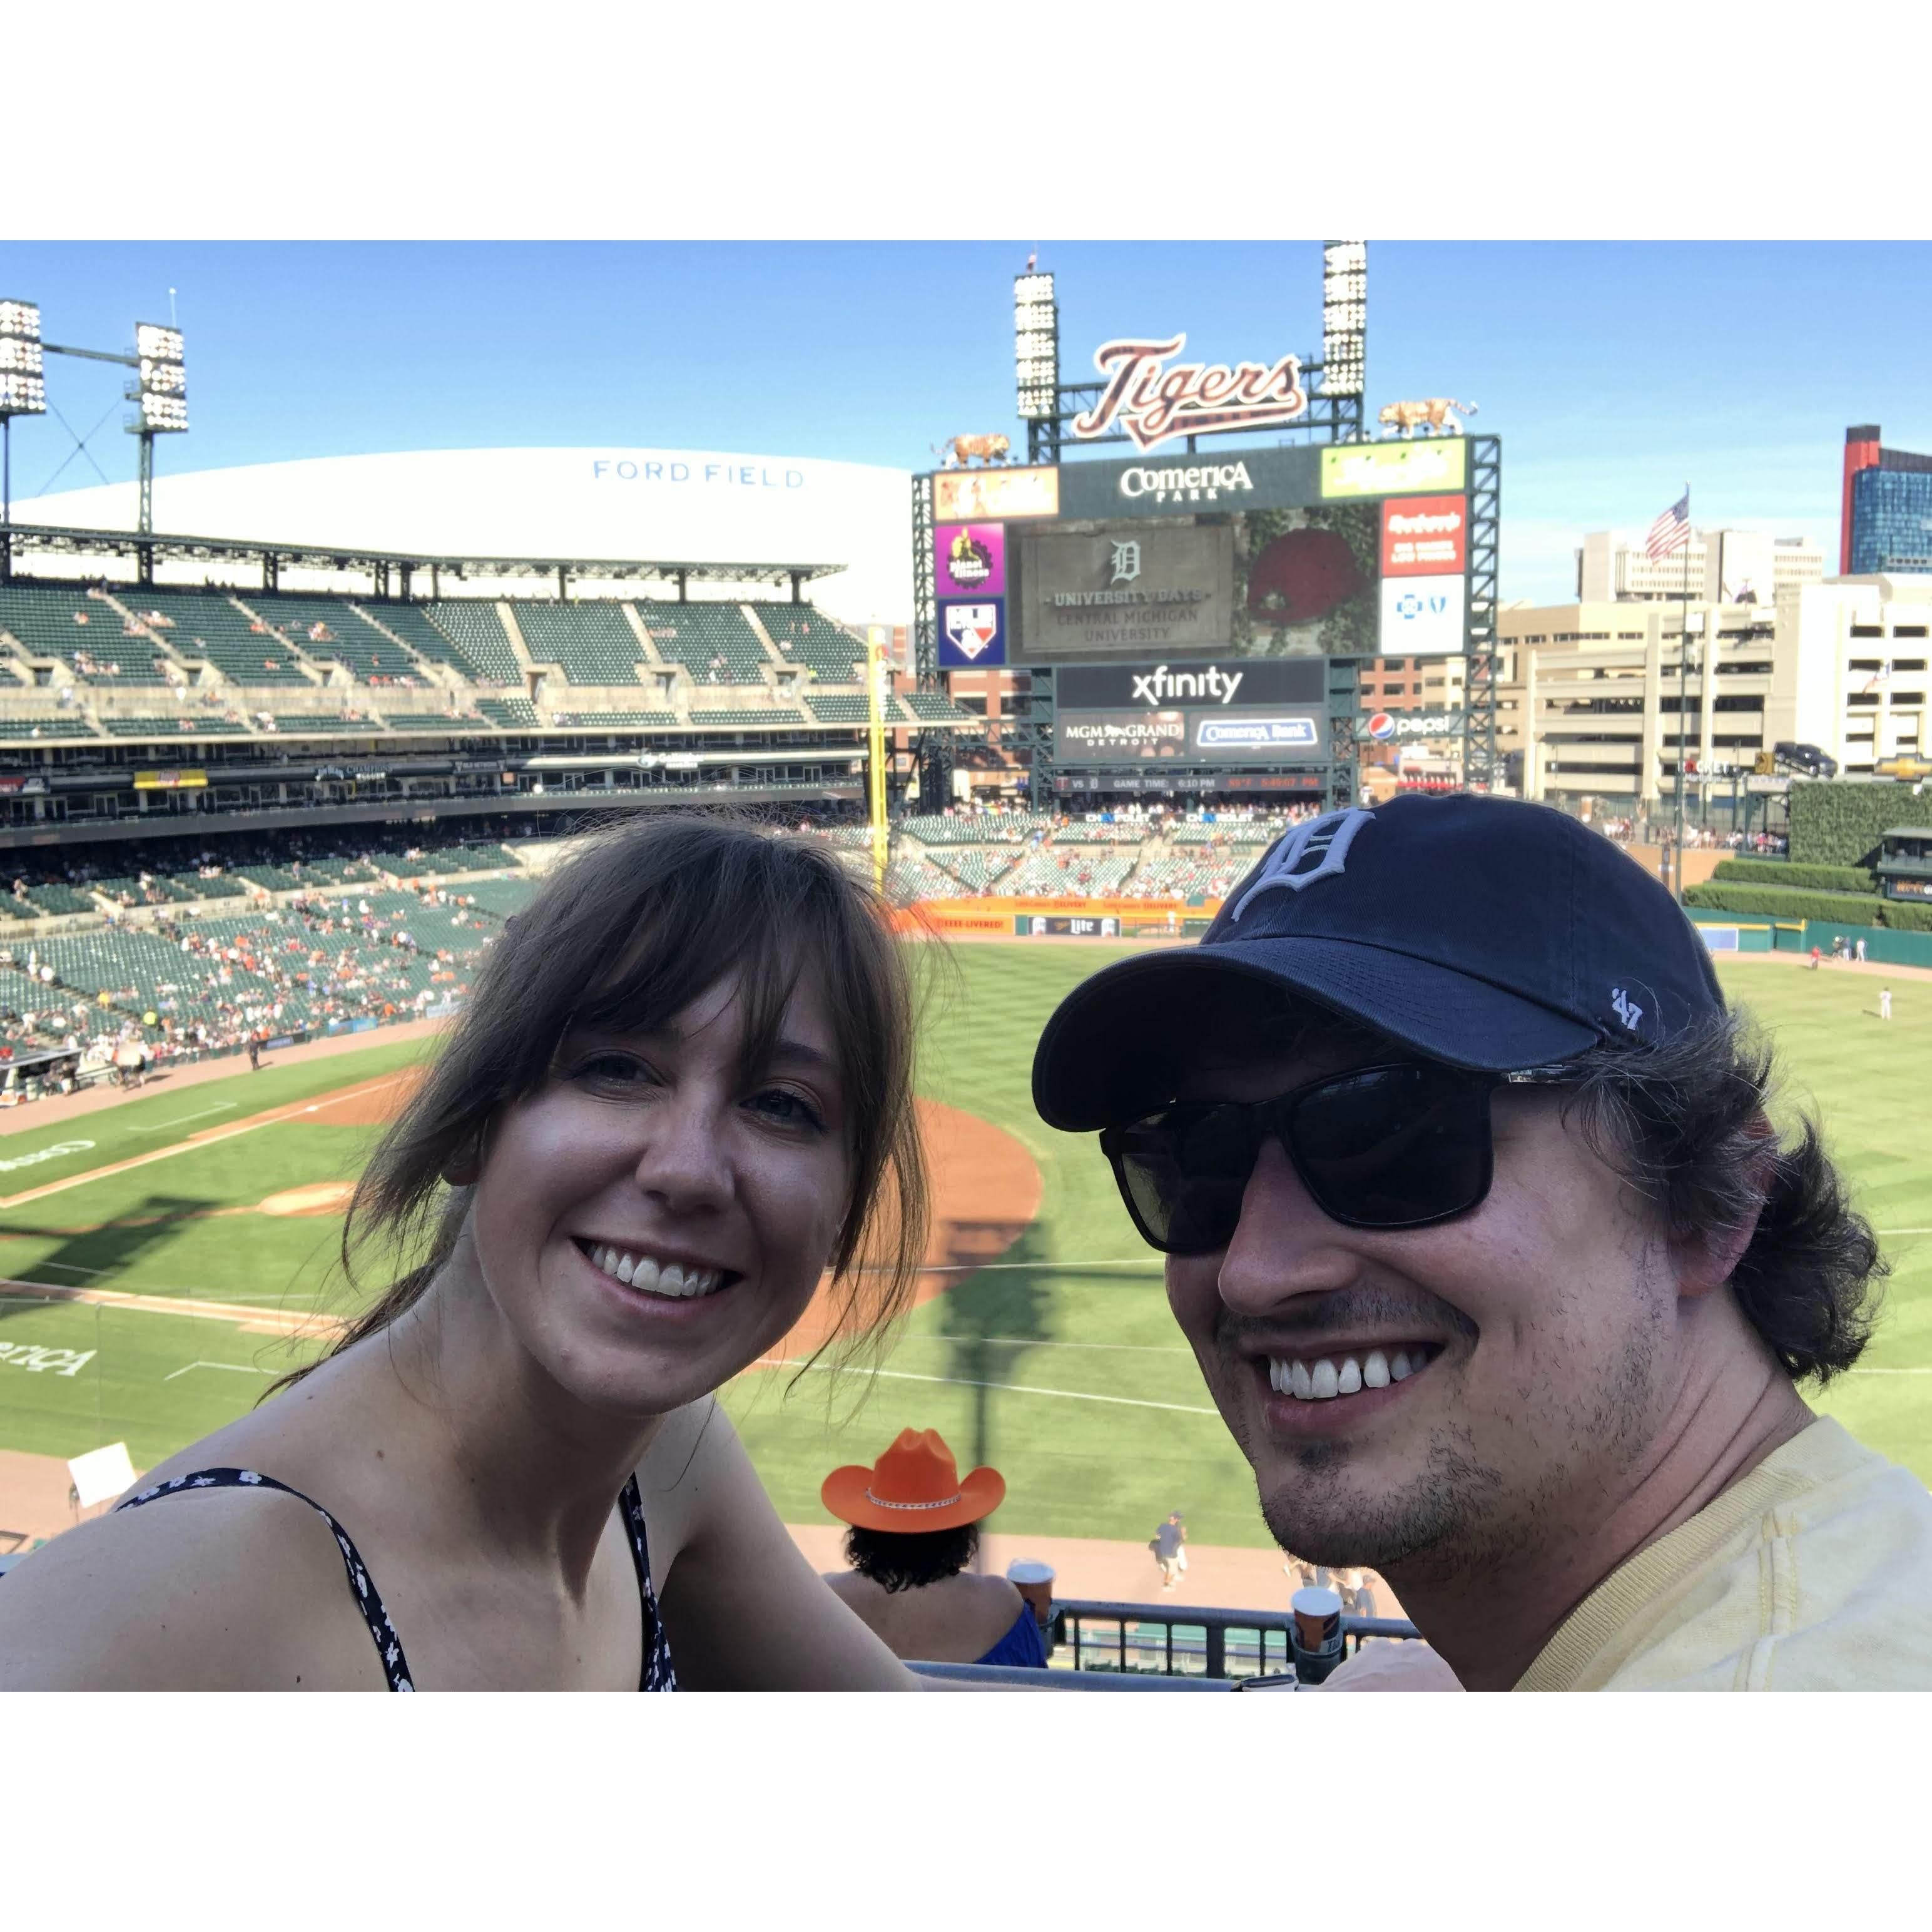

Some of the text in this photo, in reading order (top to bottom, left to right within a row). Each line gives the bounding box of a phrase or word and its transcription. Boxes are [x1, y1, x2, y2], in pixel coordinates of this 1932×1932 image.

[1072, 332, 1307, 447] Tigers
[592, 460, 804, 489] FORD FIELD
[1157, 489, 1218, 502] PARK
[1054, 590, 1150, 606] UNIVERSITY
[1057, 608, 1198, 626] CENTRAL MICHIGAN
[1084, 626, 1171, 641] UNIVERSITY
[1132, 665, 1243, 706] xfinity
[1066, 723, 1181, 738] MGM GRAND
[1396, 715, 1450, 735] pepsi
[1087, 738, 1159, 746] DETROIT
[1072, 780, 1084, 788] VS
[1113, 780, 1140, 788] GAME
[1144, 780, 1169, 788] TIME:
[1200, 778, 1216, 787] PM
